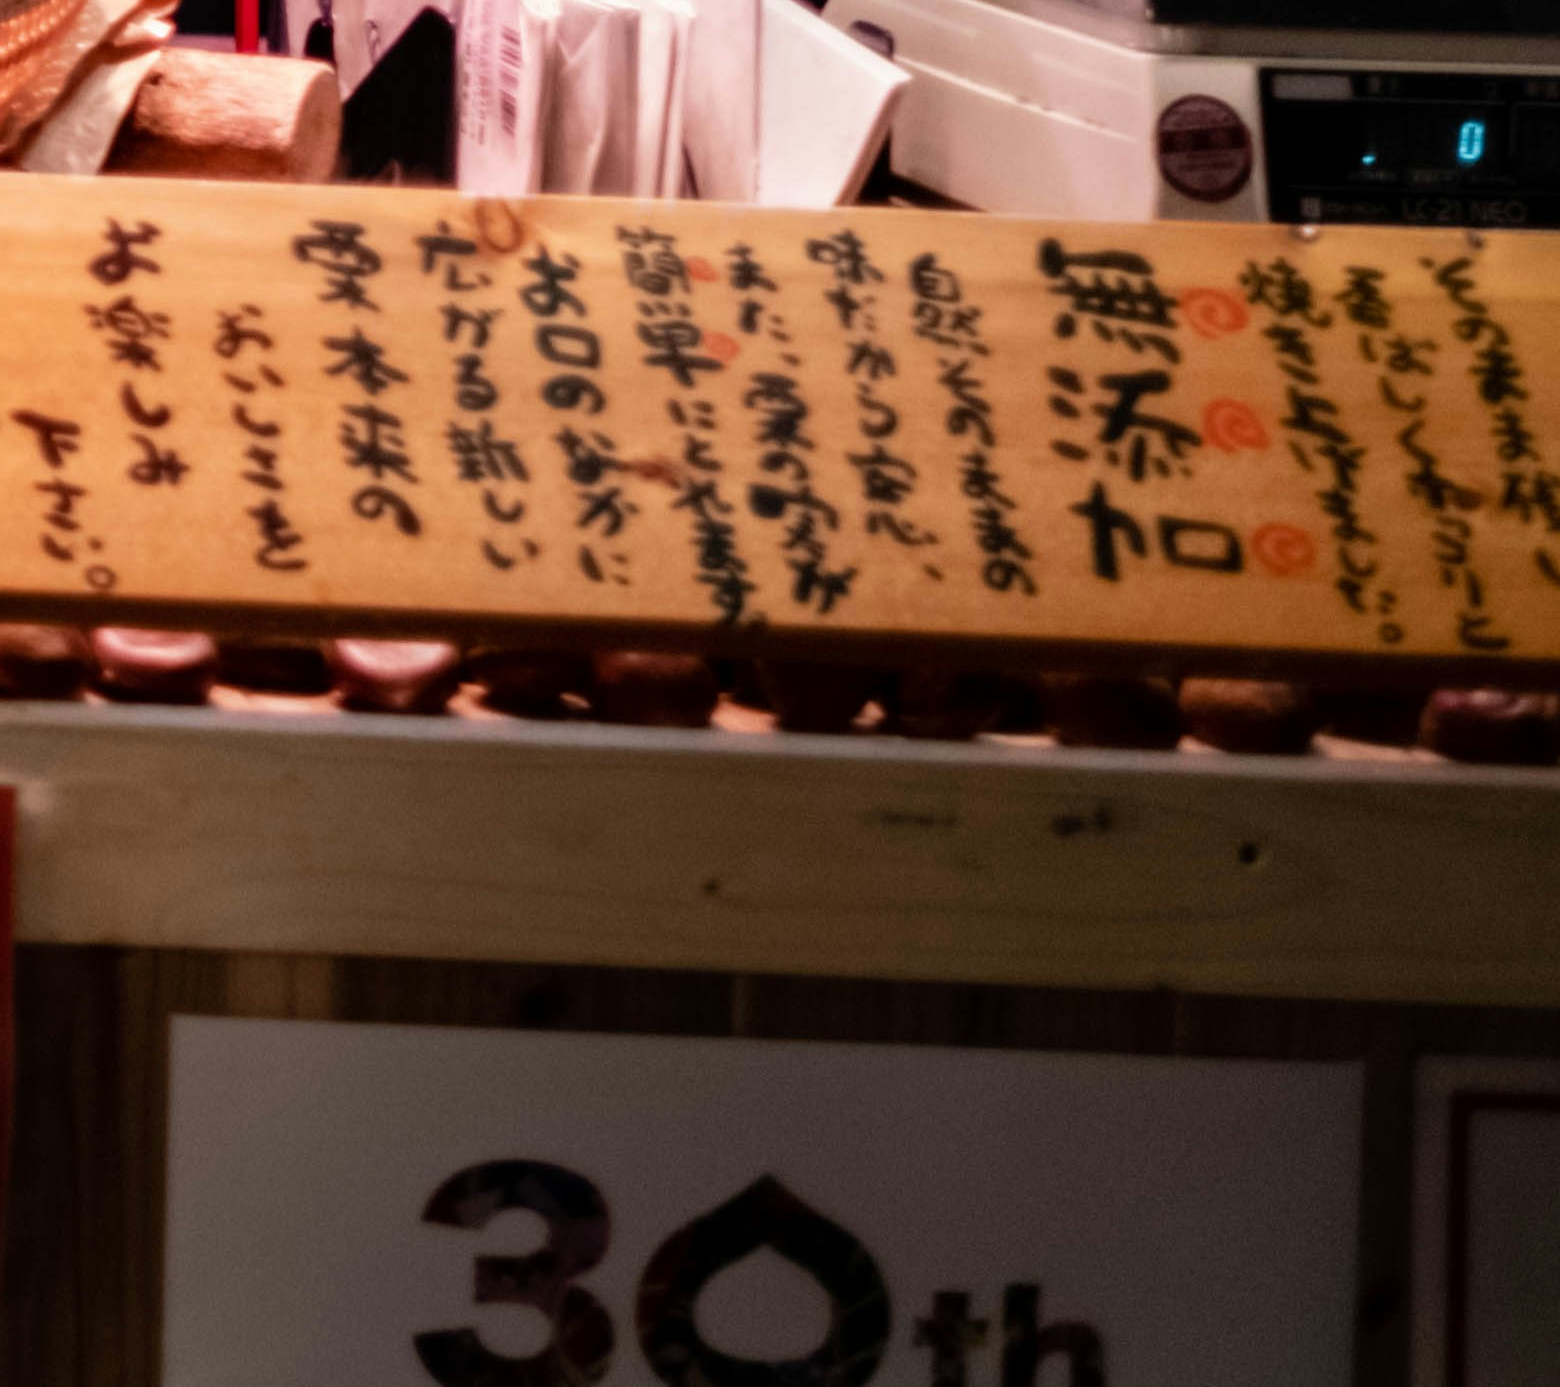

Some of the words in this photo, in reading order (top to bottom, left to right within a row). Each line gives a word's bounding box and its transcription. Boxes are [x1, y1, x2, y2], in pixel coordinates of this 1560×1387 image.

[83, 217, 190, 487] お楽しみ
[292, 219, 421, 537] 栗本来の
[1038, 235, 1246, 583] 無添加
